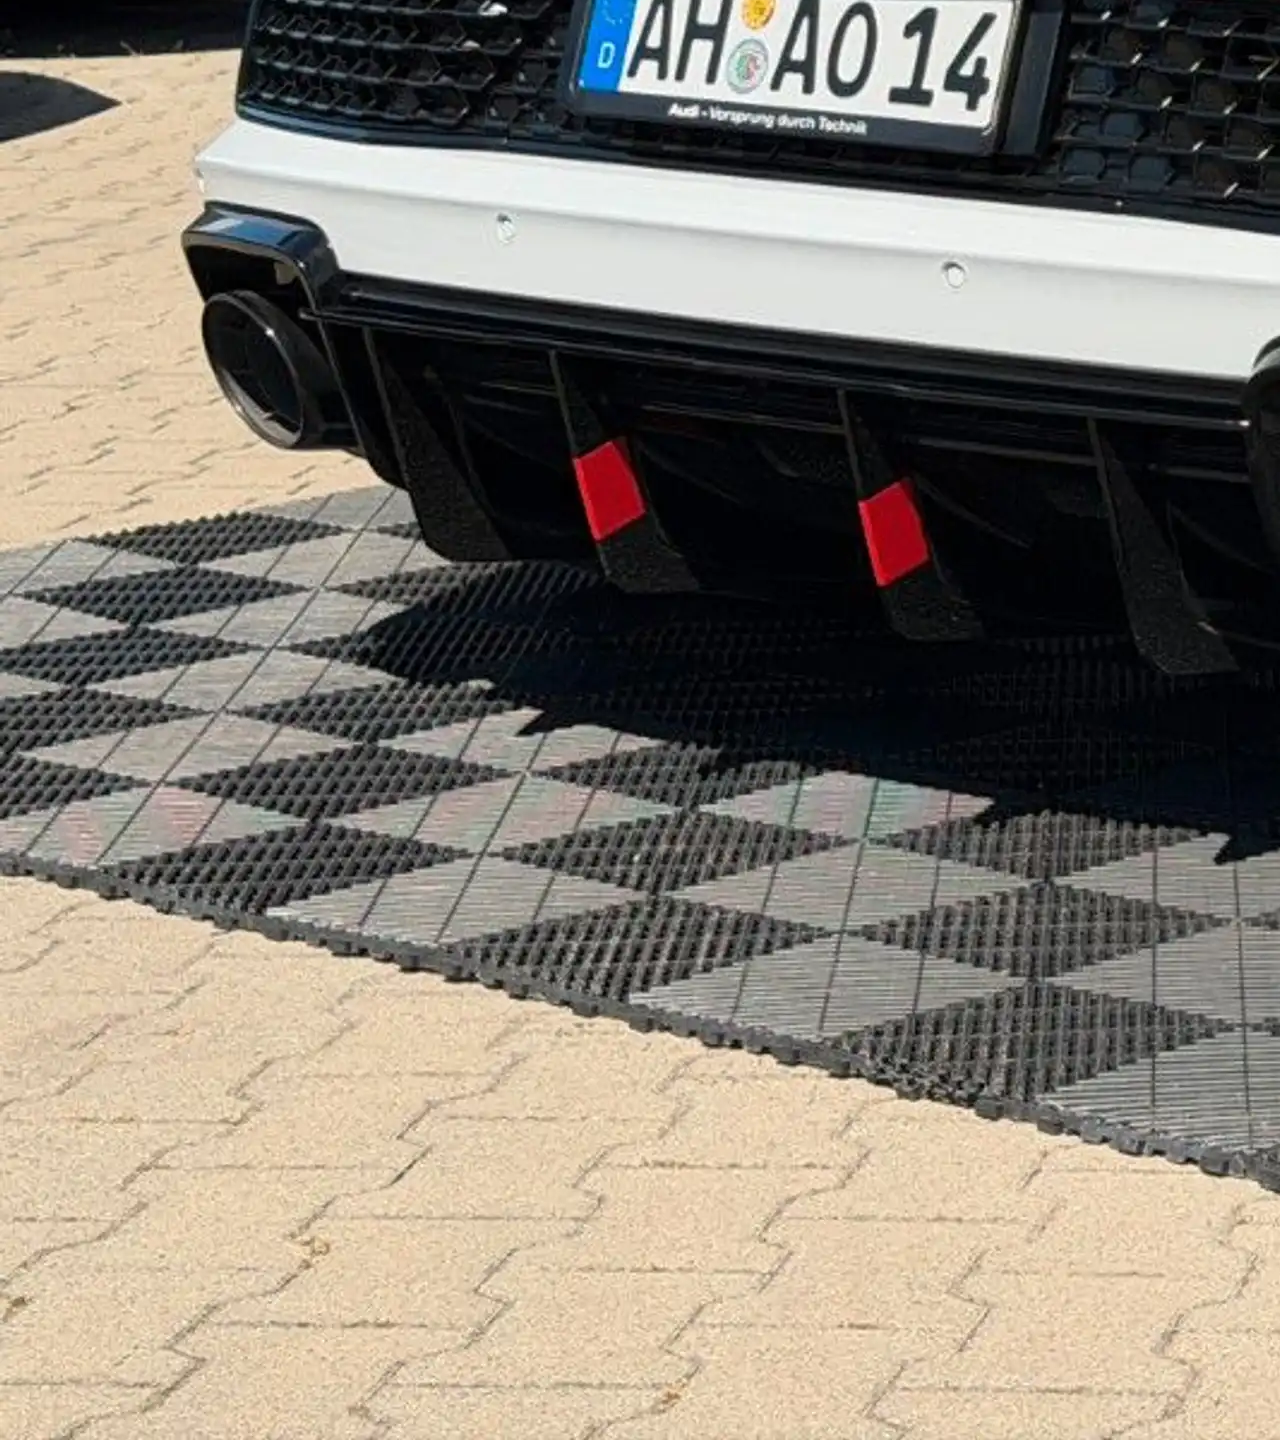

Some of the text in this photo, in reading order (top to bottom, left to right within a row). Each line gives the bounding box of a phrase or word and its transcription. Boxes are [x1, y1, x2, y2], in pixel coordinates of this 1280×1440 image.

[597, 41, 616, 69] D
[888, 6, 998, 111] 14
[667, 102, 700, 118] Audi
[710, 105, 775, 128] Vorsprung
[777, 112, 816, 130] durch
[818, 115, 868, 135] Technik
